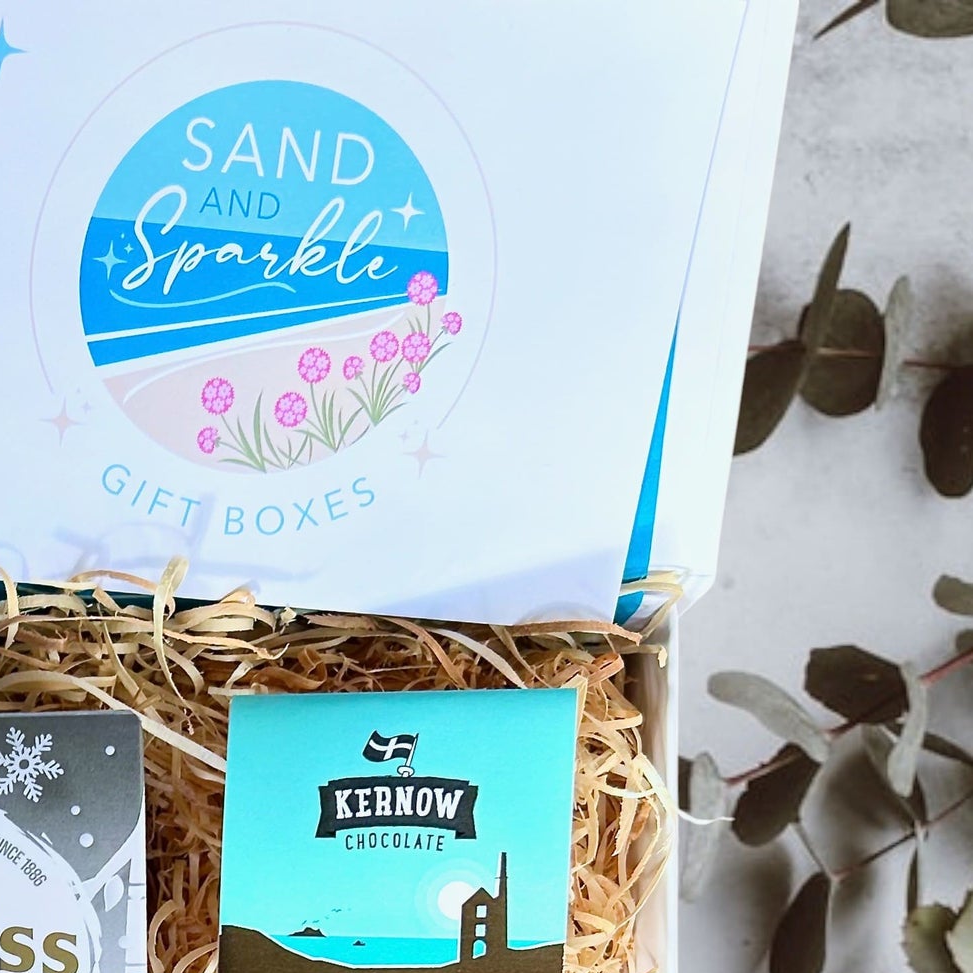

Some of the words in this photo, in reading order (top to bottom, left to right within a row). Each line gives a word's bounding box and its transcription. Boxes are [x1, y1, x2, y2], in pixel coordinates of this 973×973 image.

[182, 117, 375, 186] SAND
[199, 187, 281, 220] AND
[122, 185, 399, 295] Sparkle
[102, 464, 202, 527] GIFT
[223, 477, 375, 535] BOXES
[334, 785, 463, 820] KERNOW
[345, 832, 446, 852] CHOCOLATE
[20, 858, 47, 887] 1886
